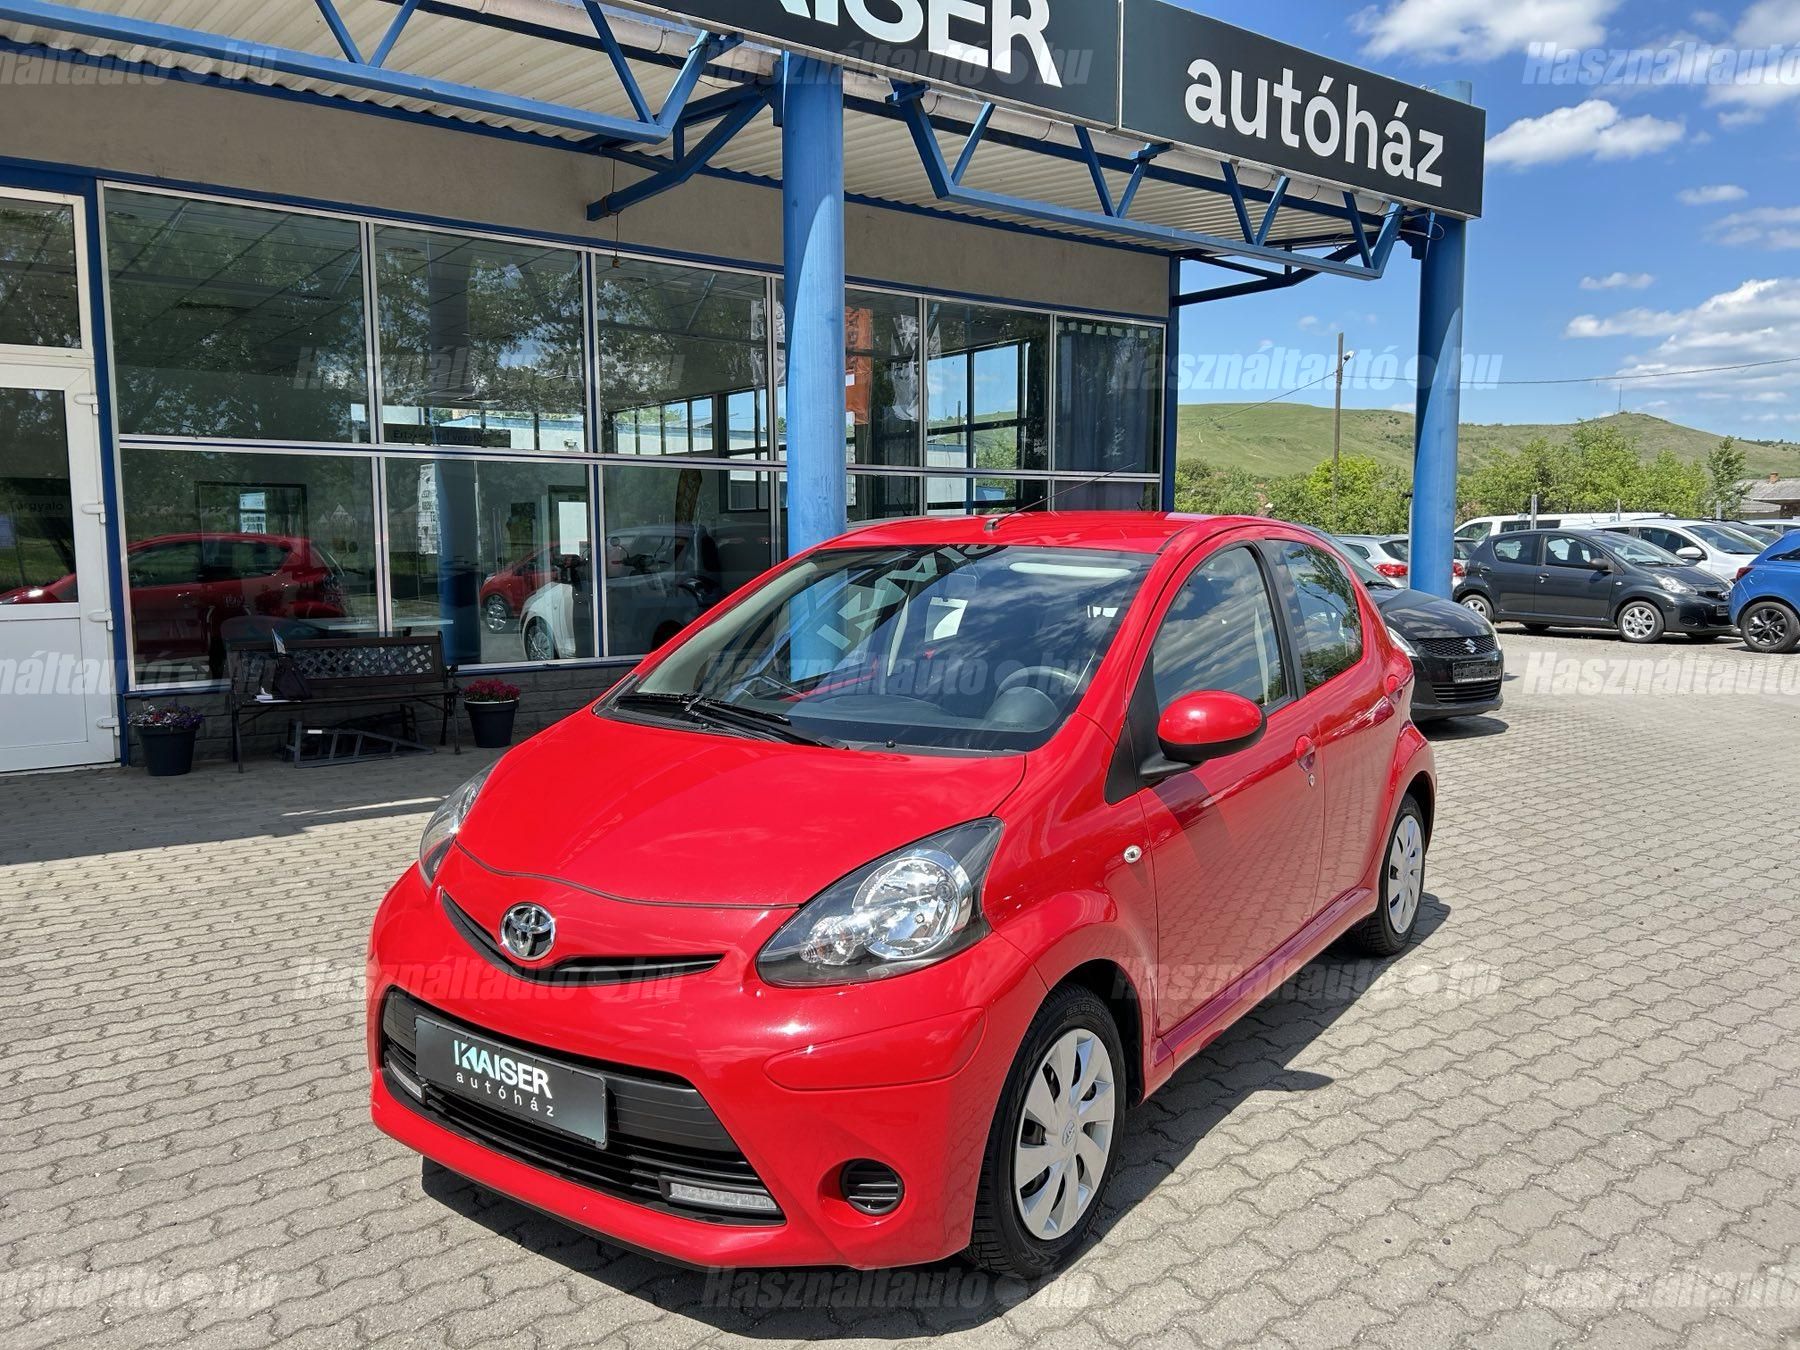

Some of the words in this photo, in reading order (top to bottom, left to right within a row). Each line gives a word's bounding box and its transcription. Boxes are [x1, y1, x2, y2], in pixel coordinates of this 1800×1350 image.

[1184, 58, 1444, 188] autóház
[454, 1040, 552, 1099] KAISER
[456, 1071, 553, 1117] autóház
